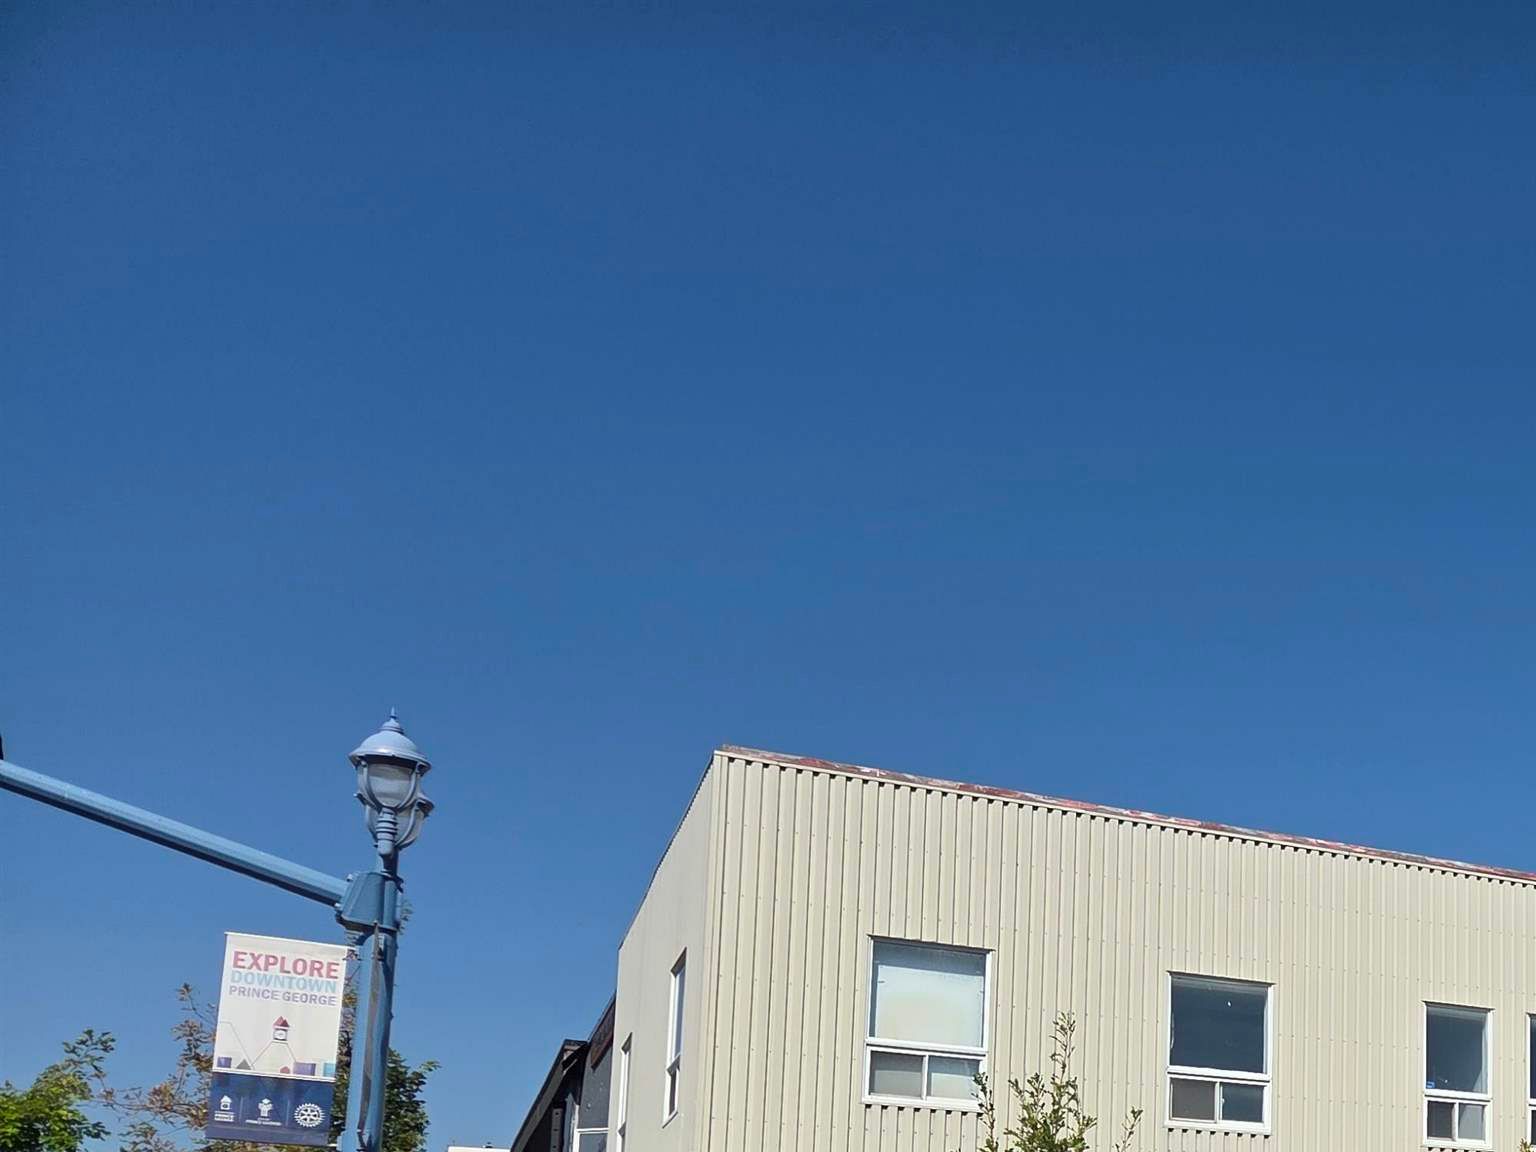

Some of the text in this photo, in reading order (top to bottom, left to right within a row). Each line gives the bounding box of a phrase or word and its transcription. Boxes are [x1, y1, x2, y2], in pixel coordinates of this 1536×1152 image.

[232, 951, 340, 979] EXPLORE
[231, 970, 337, 993] DOWNTOWN
[229, 985, 337, 1006] PRINCE GEORGE
